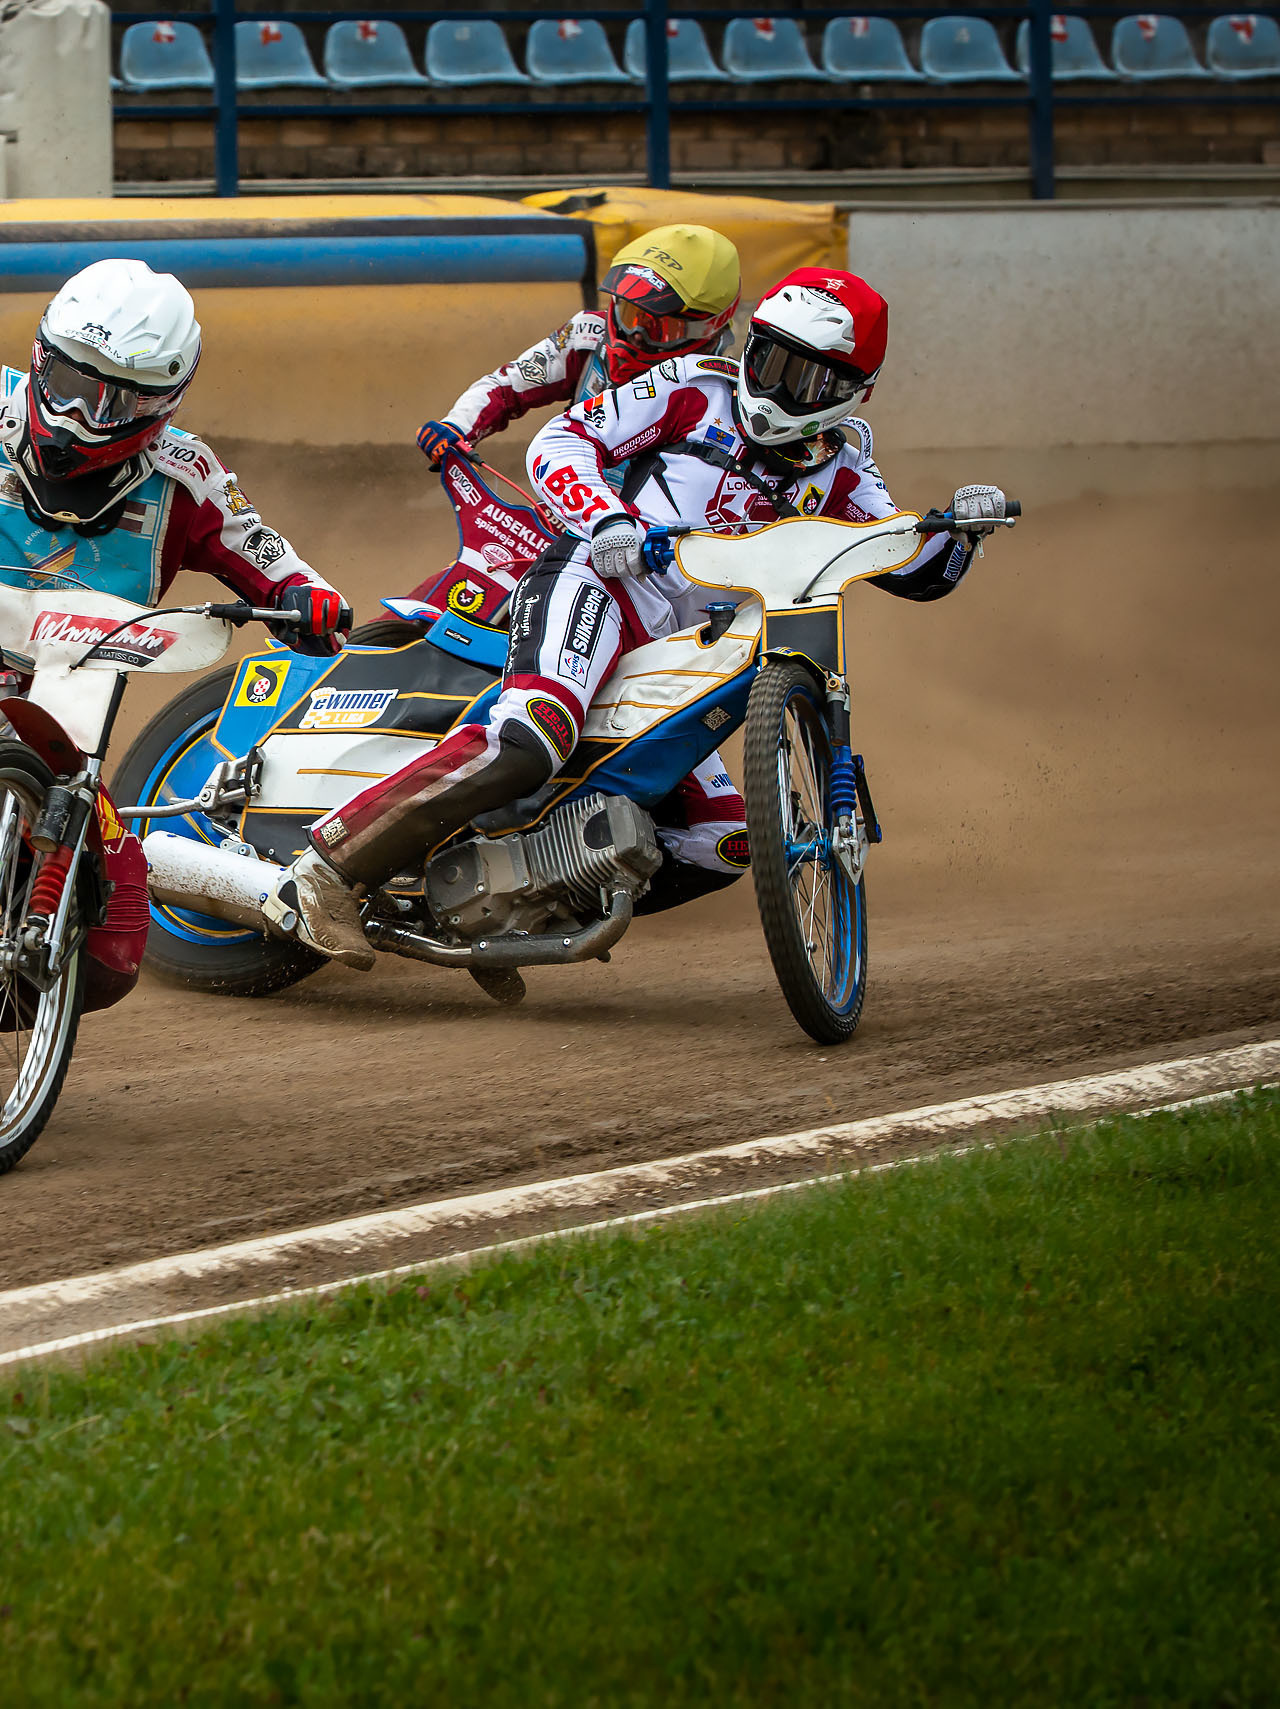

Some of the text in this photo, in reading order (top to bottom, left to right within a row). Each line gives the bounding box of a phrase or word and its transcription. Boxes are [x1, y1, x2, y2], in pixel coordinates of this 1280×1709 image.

[613, 426, 657, 456] BRODDSON
[544, 465, 611, 522] BST
[482, 503, 553, 552] AUSEKLIS
[572, 588, 605, 653] Silkolene
[570, 655, 580, 677] FUCHS
